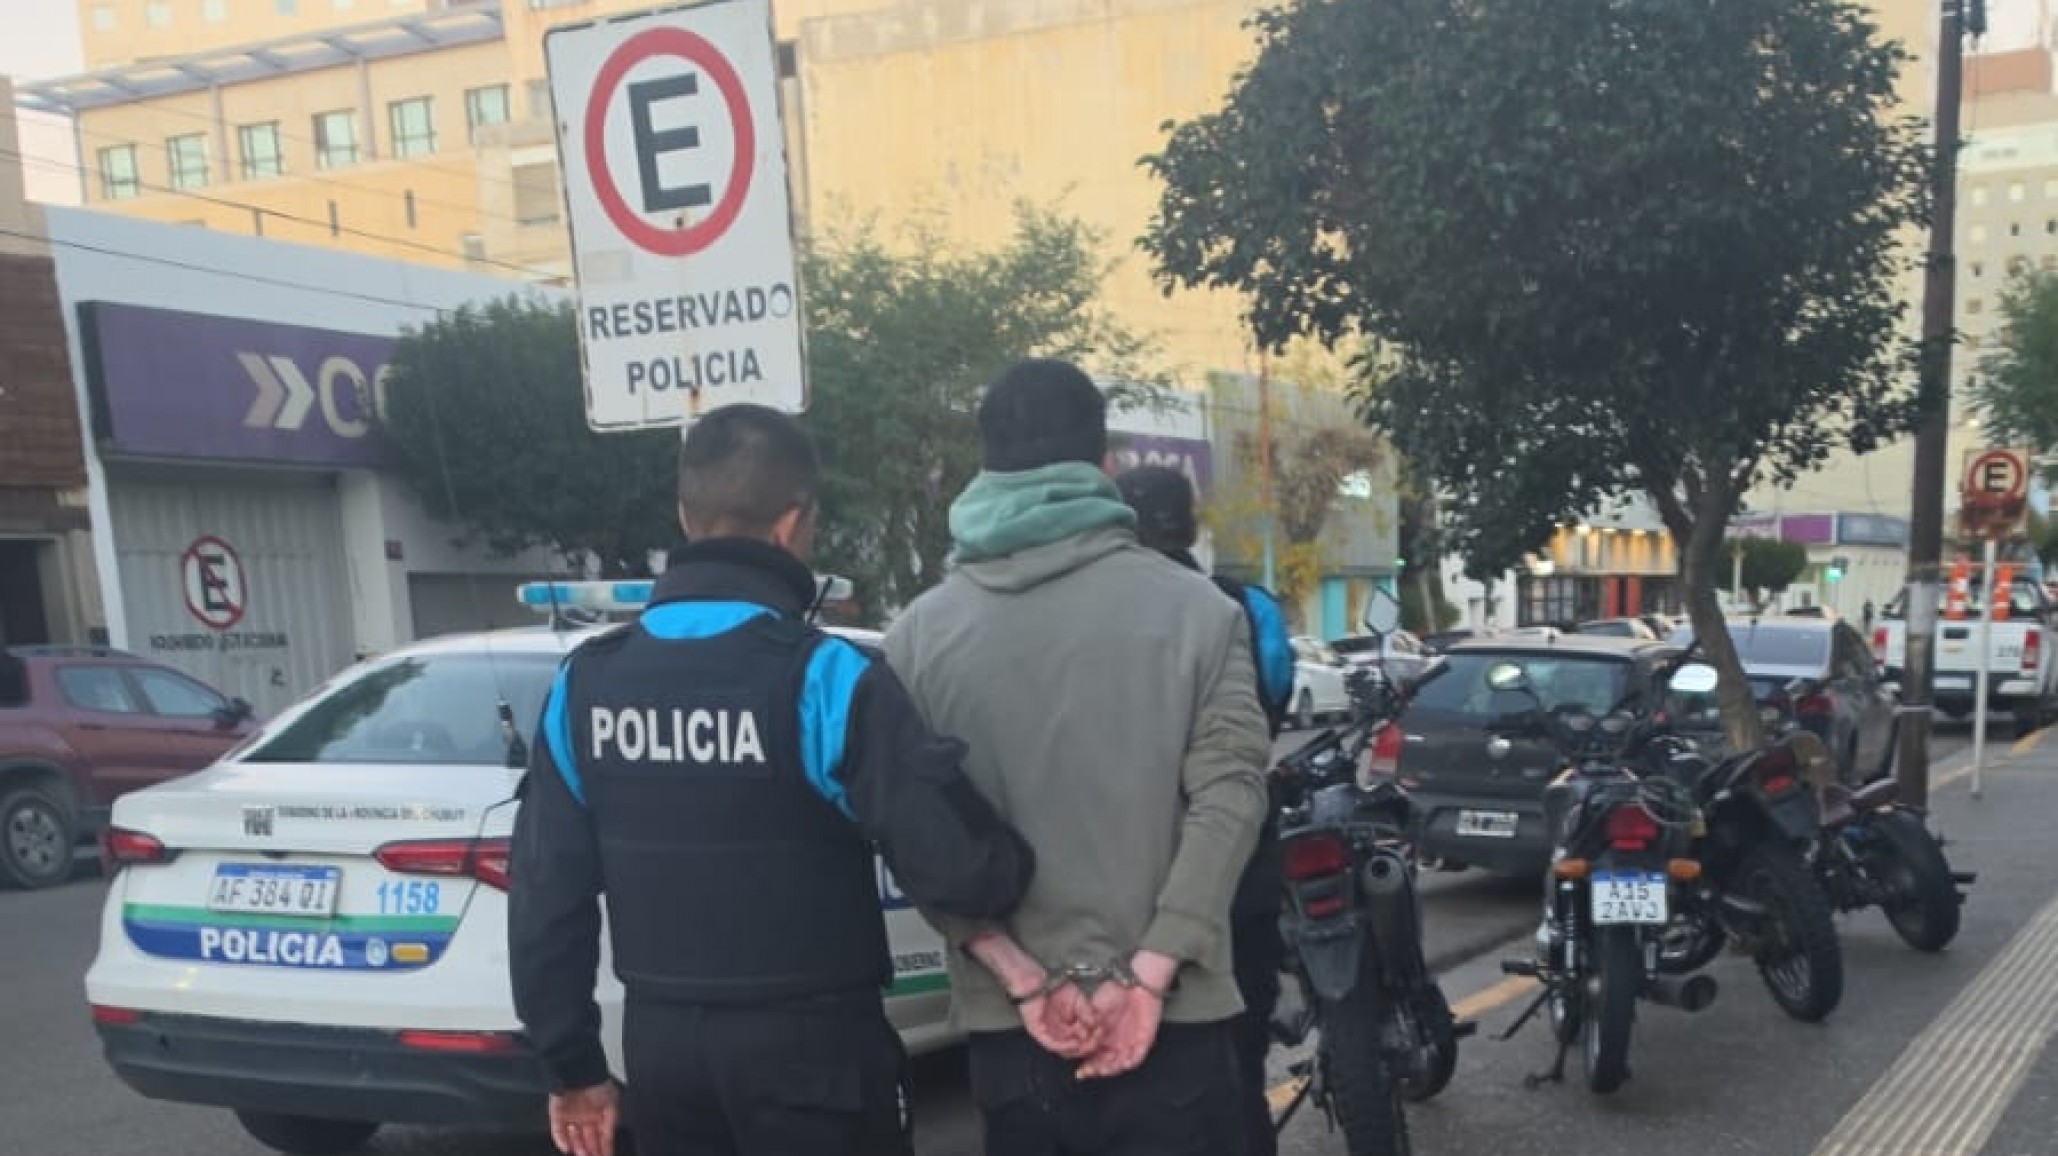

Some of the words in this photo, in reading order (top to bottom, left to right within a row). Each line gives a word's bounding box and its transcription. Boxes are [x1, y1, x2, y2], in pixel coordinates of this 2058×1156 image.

[628, 71, 713, 214] E
[589, 281, 792, 341] RESERVADO
[626, 347, 762, 395] POLICIA
[1984, 461, 2008, 492] E
[591, 705, 767, 764] POLICIA
[214, 878, 245, 904] AF
[249, 879, 290, 908] 384
[376, 880, 440, 915] 1158
[200, 926, 344, 967] POLICIA
